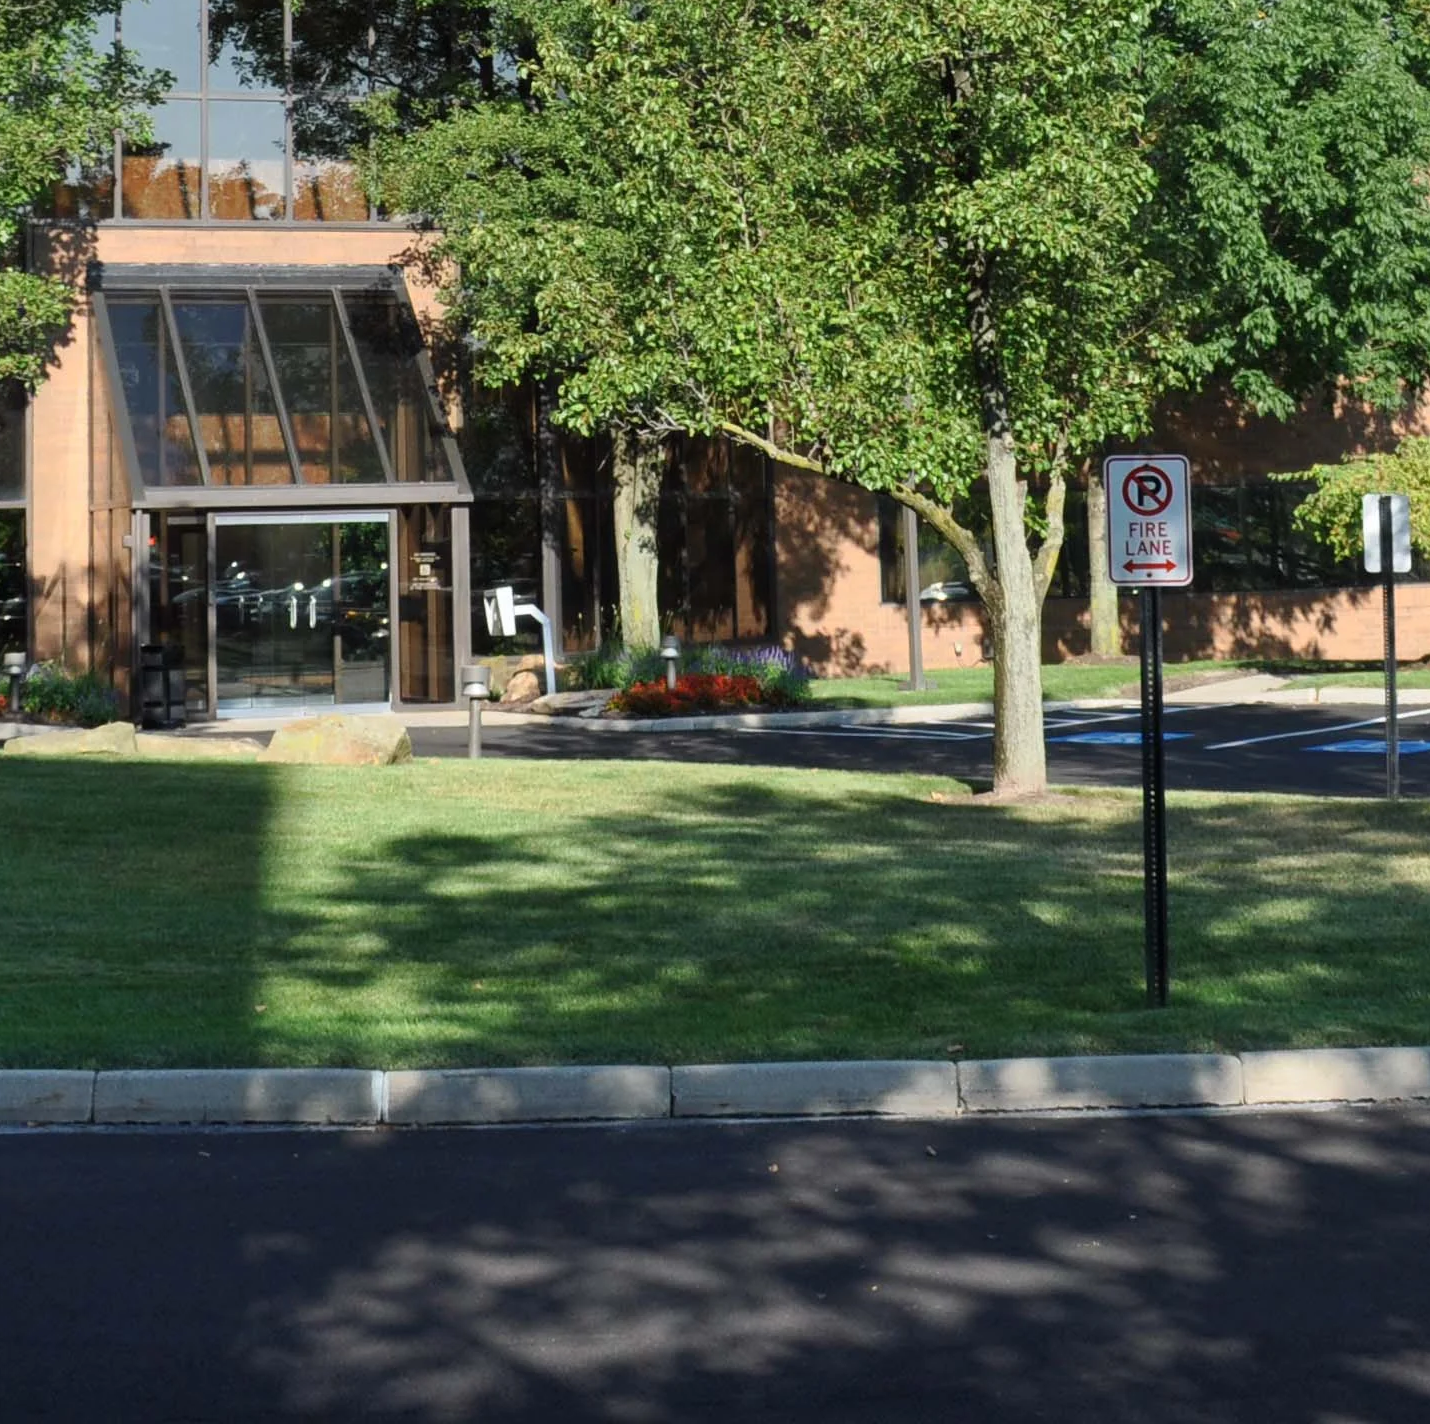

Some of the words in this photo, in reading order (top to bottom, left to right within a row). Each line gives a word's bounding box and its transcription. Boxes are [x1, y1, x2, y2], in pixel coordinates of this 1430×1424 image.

[1137, 475, 1162, 507] P
[1129, 522, 1168, 538] FIRE
[1125, 540, 1173, 557] LANE
